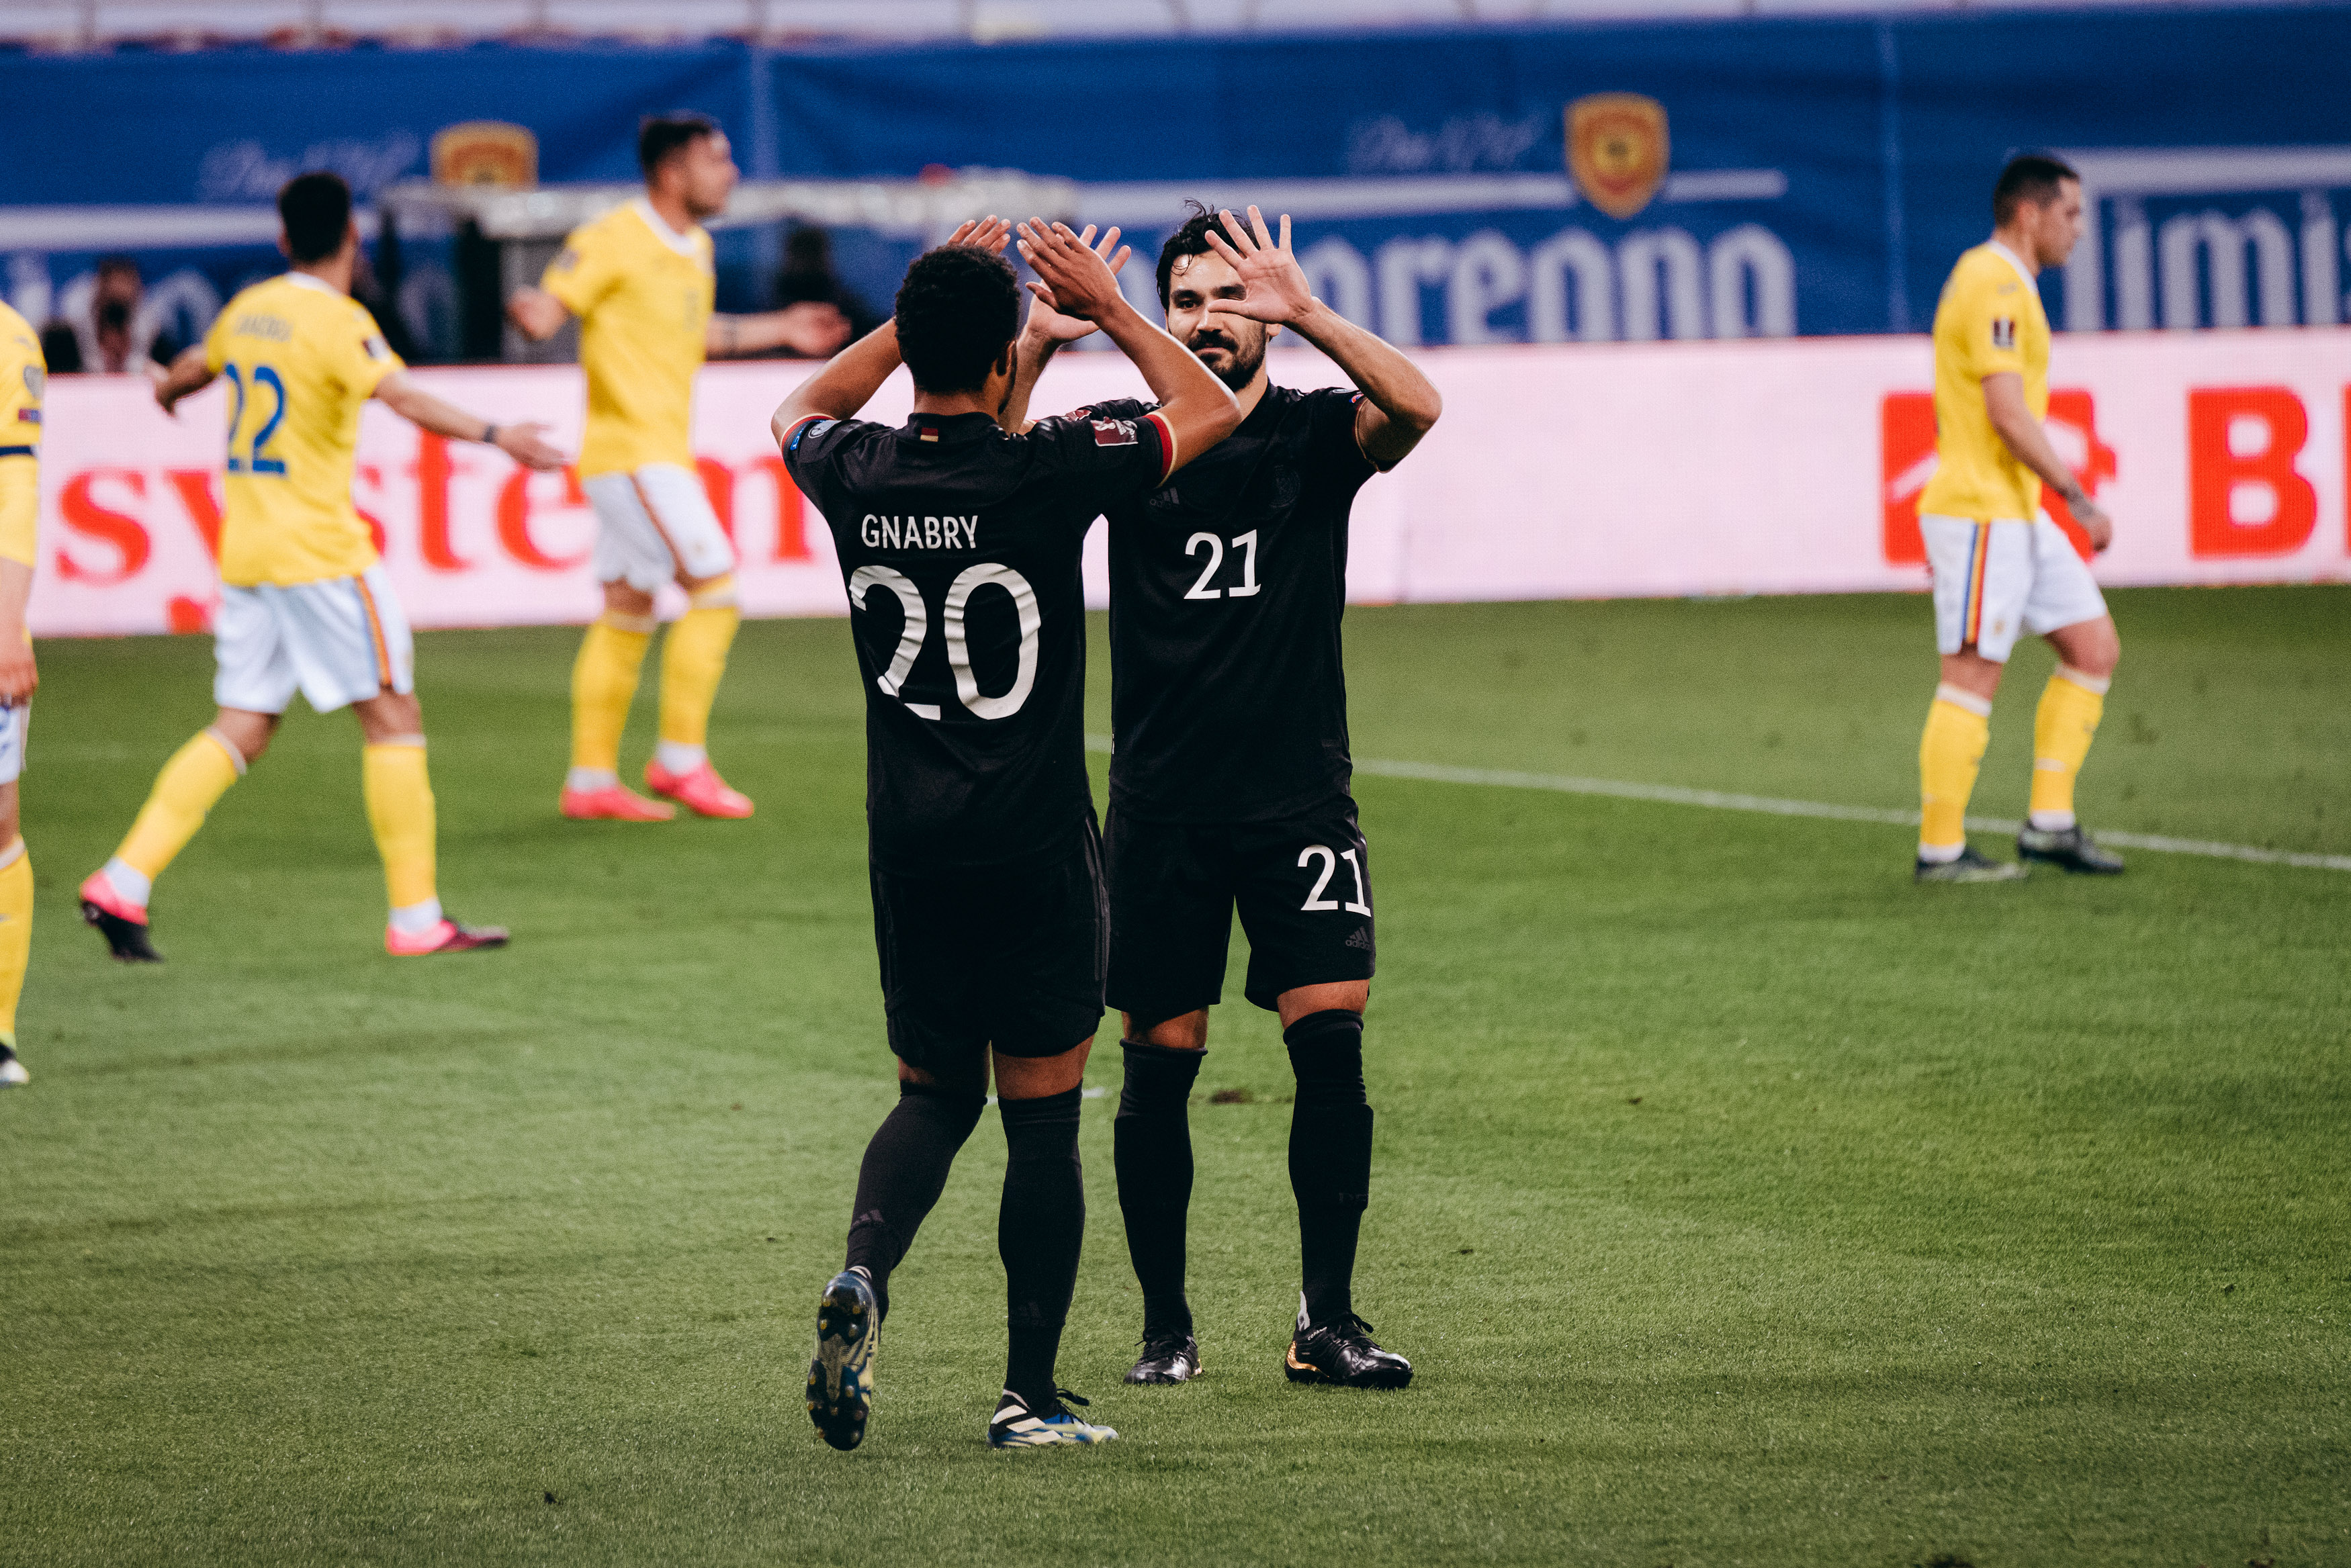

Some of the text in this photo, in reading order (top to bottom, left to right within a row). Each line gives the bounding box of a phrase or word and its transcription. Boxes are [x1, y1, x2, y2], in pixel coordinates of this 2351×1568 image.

[861, 513, 979, 550] GNABRY
[1183, 528, 1262, 600] 21
[848, 562, 1042, 721] 20
[1297, 844, 1372, 917] 21
